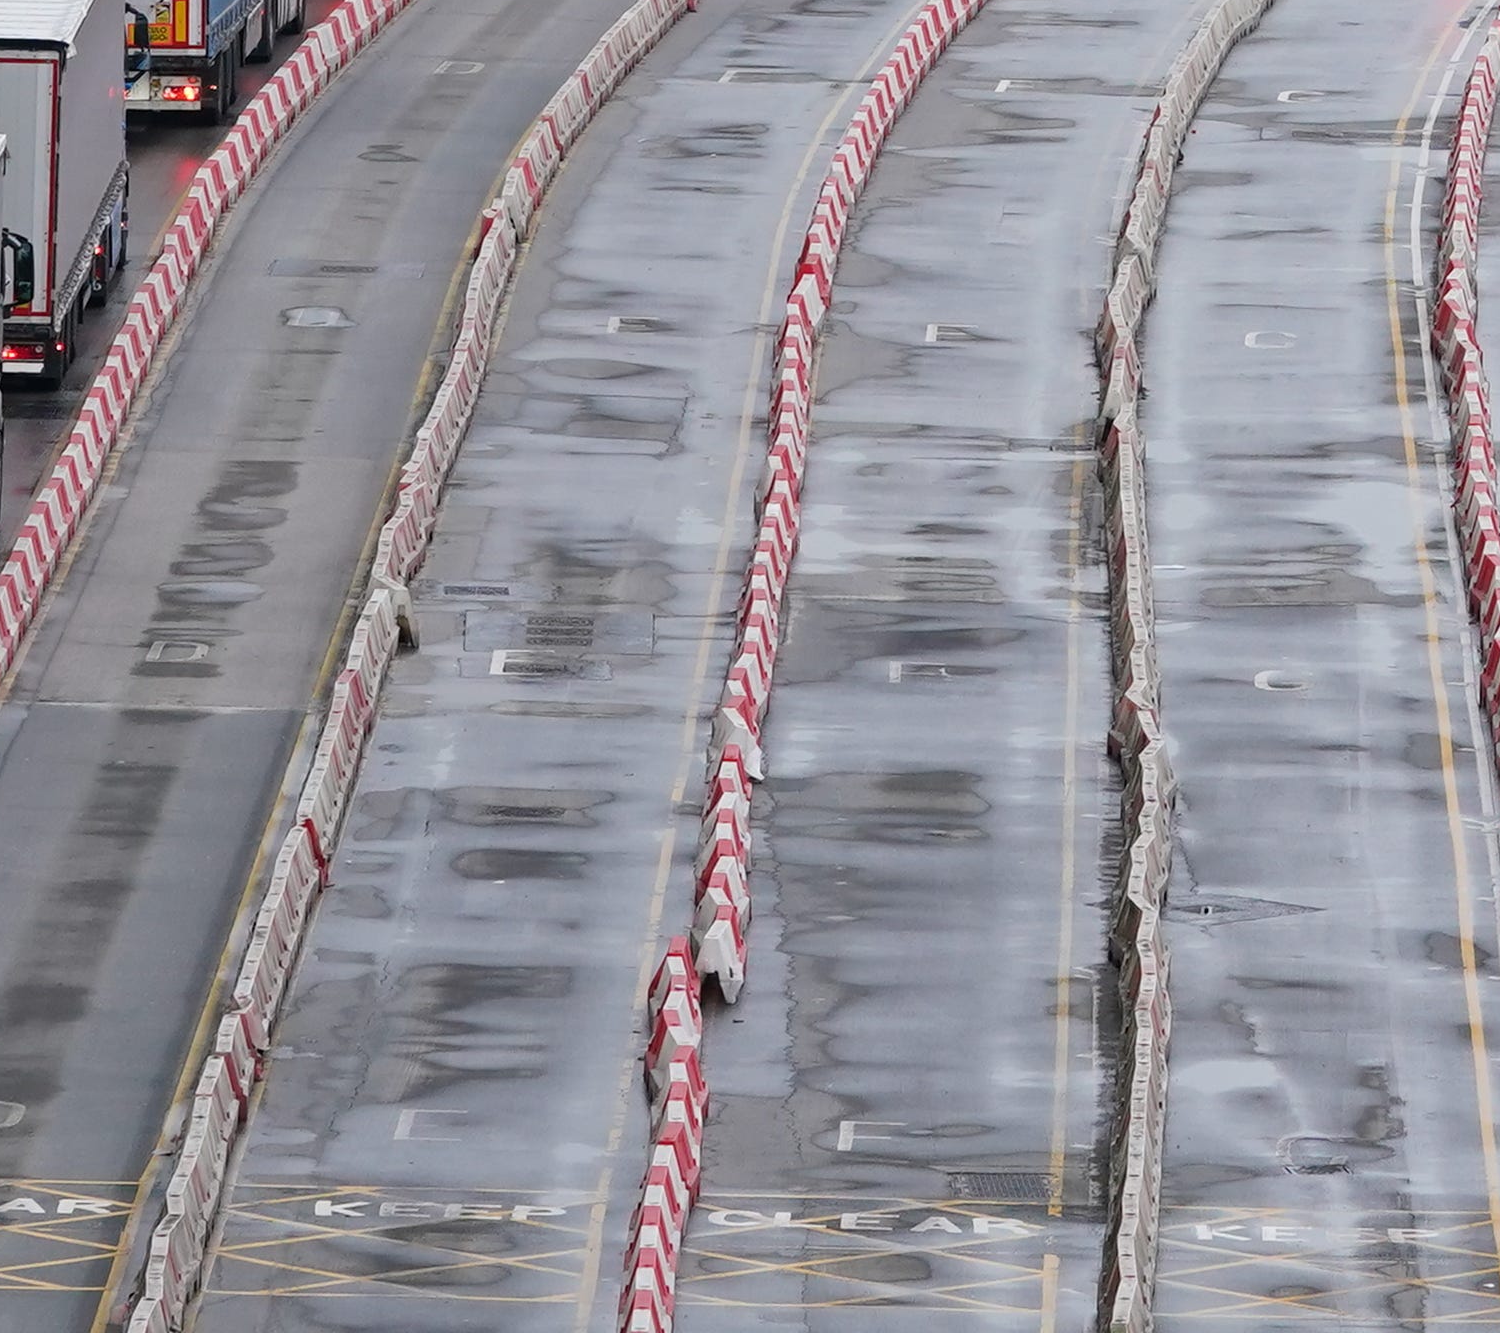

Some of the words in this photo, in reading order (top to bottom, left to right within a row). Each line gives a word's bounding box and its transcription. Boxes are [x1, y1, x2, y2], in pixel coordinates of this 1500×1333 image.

[393, 1108, 468, 1141] E
[836, 1120, 908, 1151] F
[312, 1197, 570, 1221] KEEP
[703, 1208, 1050, 1236] CLEAR
[1196, 1224, 1440, 1243] KEEP
